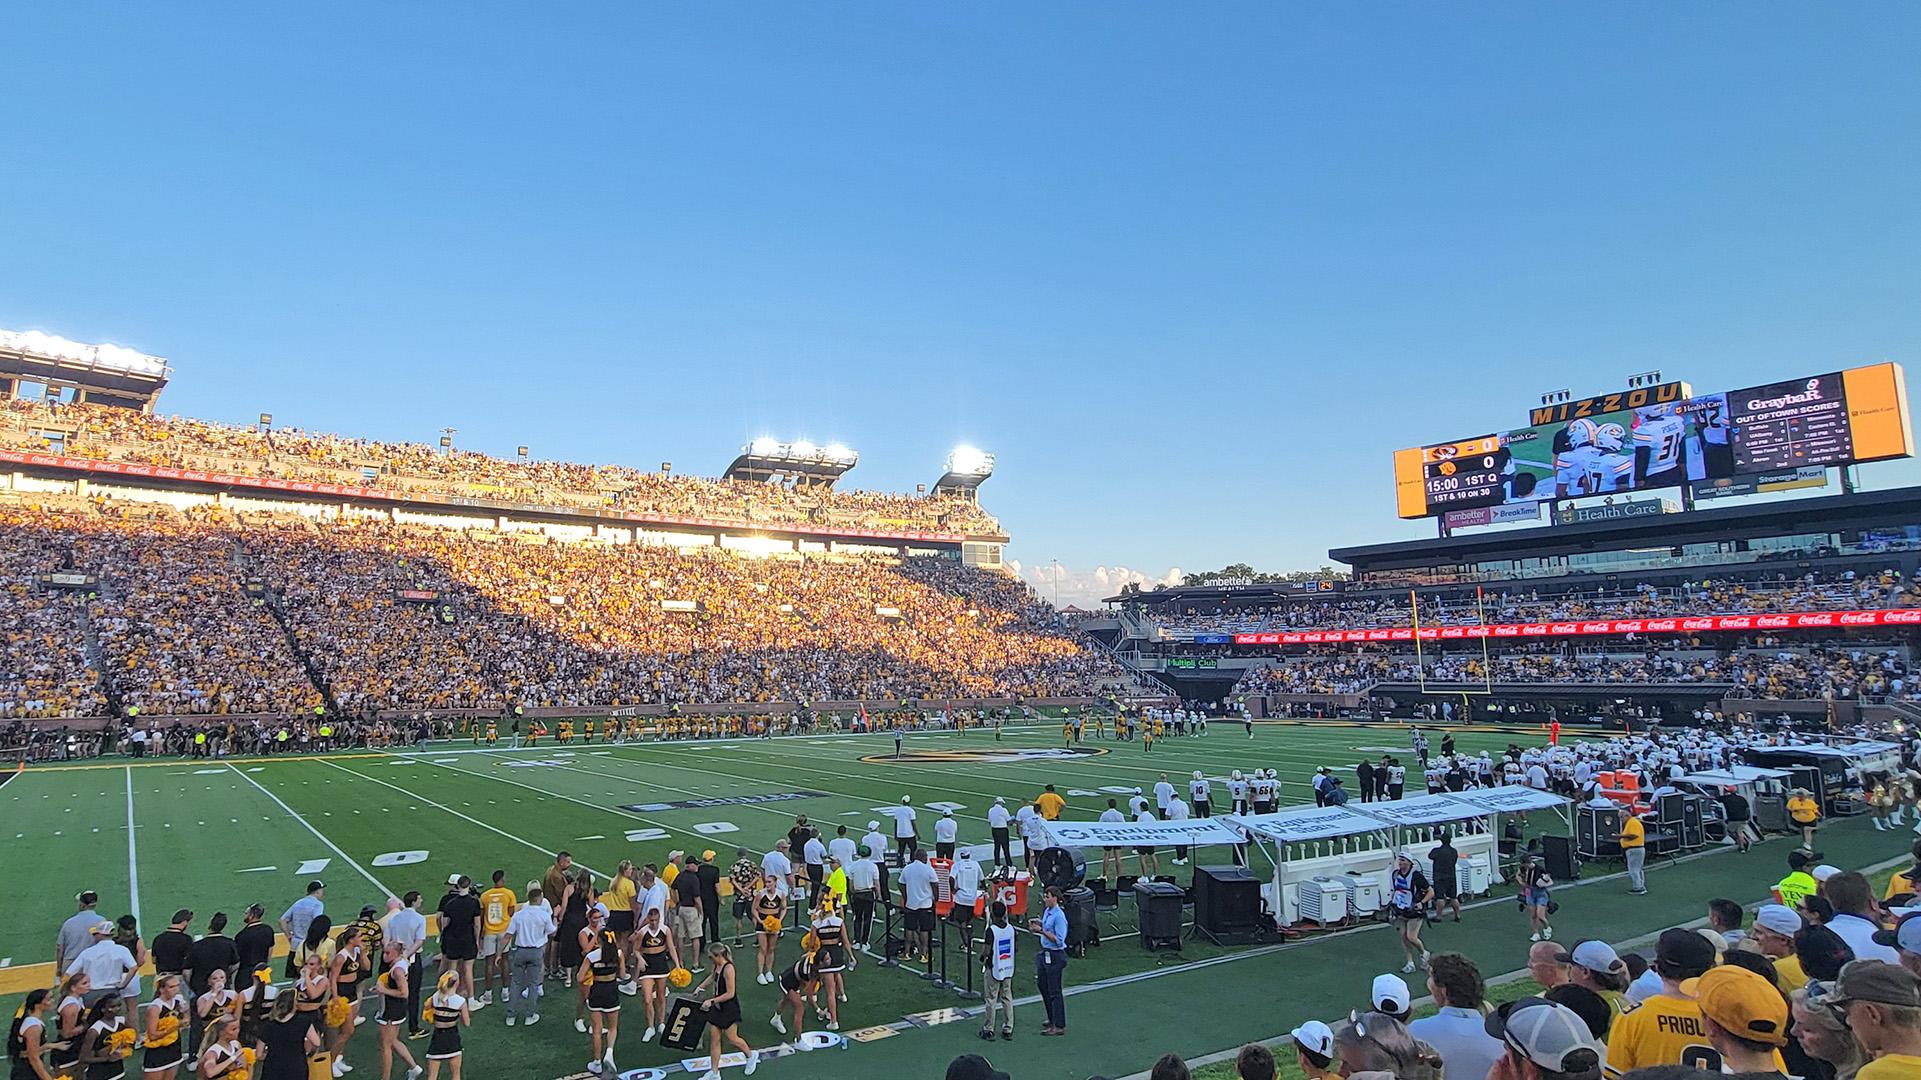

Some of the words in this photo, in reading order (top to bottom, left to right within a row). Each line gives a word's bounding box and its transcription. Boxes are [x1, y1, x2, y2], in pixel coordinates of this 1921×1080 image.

[1736, 415, 1756, 424] OUT
[1799, 401, 1841, 413] SCORES
[1481, 440, 1493, 451] 0
[1483, 456, 1494, 469] 0
[1427, 478, 1459, 493] 15:00
[1465, 475, 1485, 486] 1ST
[1488, 474, 1497, 482] Q
[1434, 494, 1449, 502] 1ST
[1457, 491, 1466, 499] 10
[1480, 488, 1491, 496] 30
[1449, 509, 1485, 521] ambetter
[1578, 505, 1621, 522] Health
[1624, 502, 1657, 516] Care
[1203, 576, 1245, 587] ambetter
[1320, 581, 1331, 590] 24
[1195, 785, 1204, 795] 10
[1088, 823, 1222, 836] Equipment
[1096, 833, 1169, 842] Share
